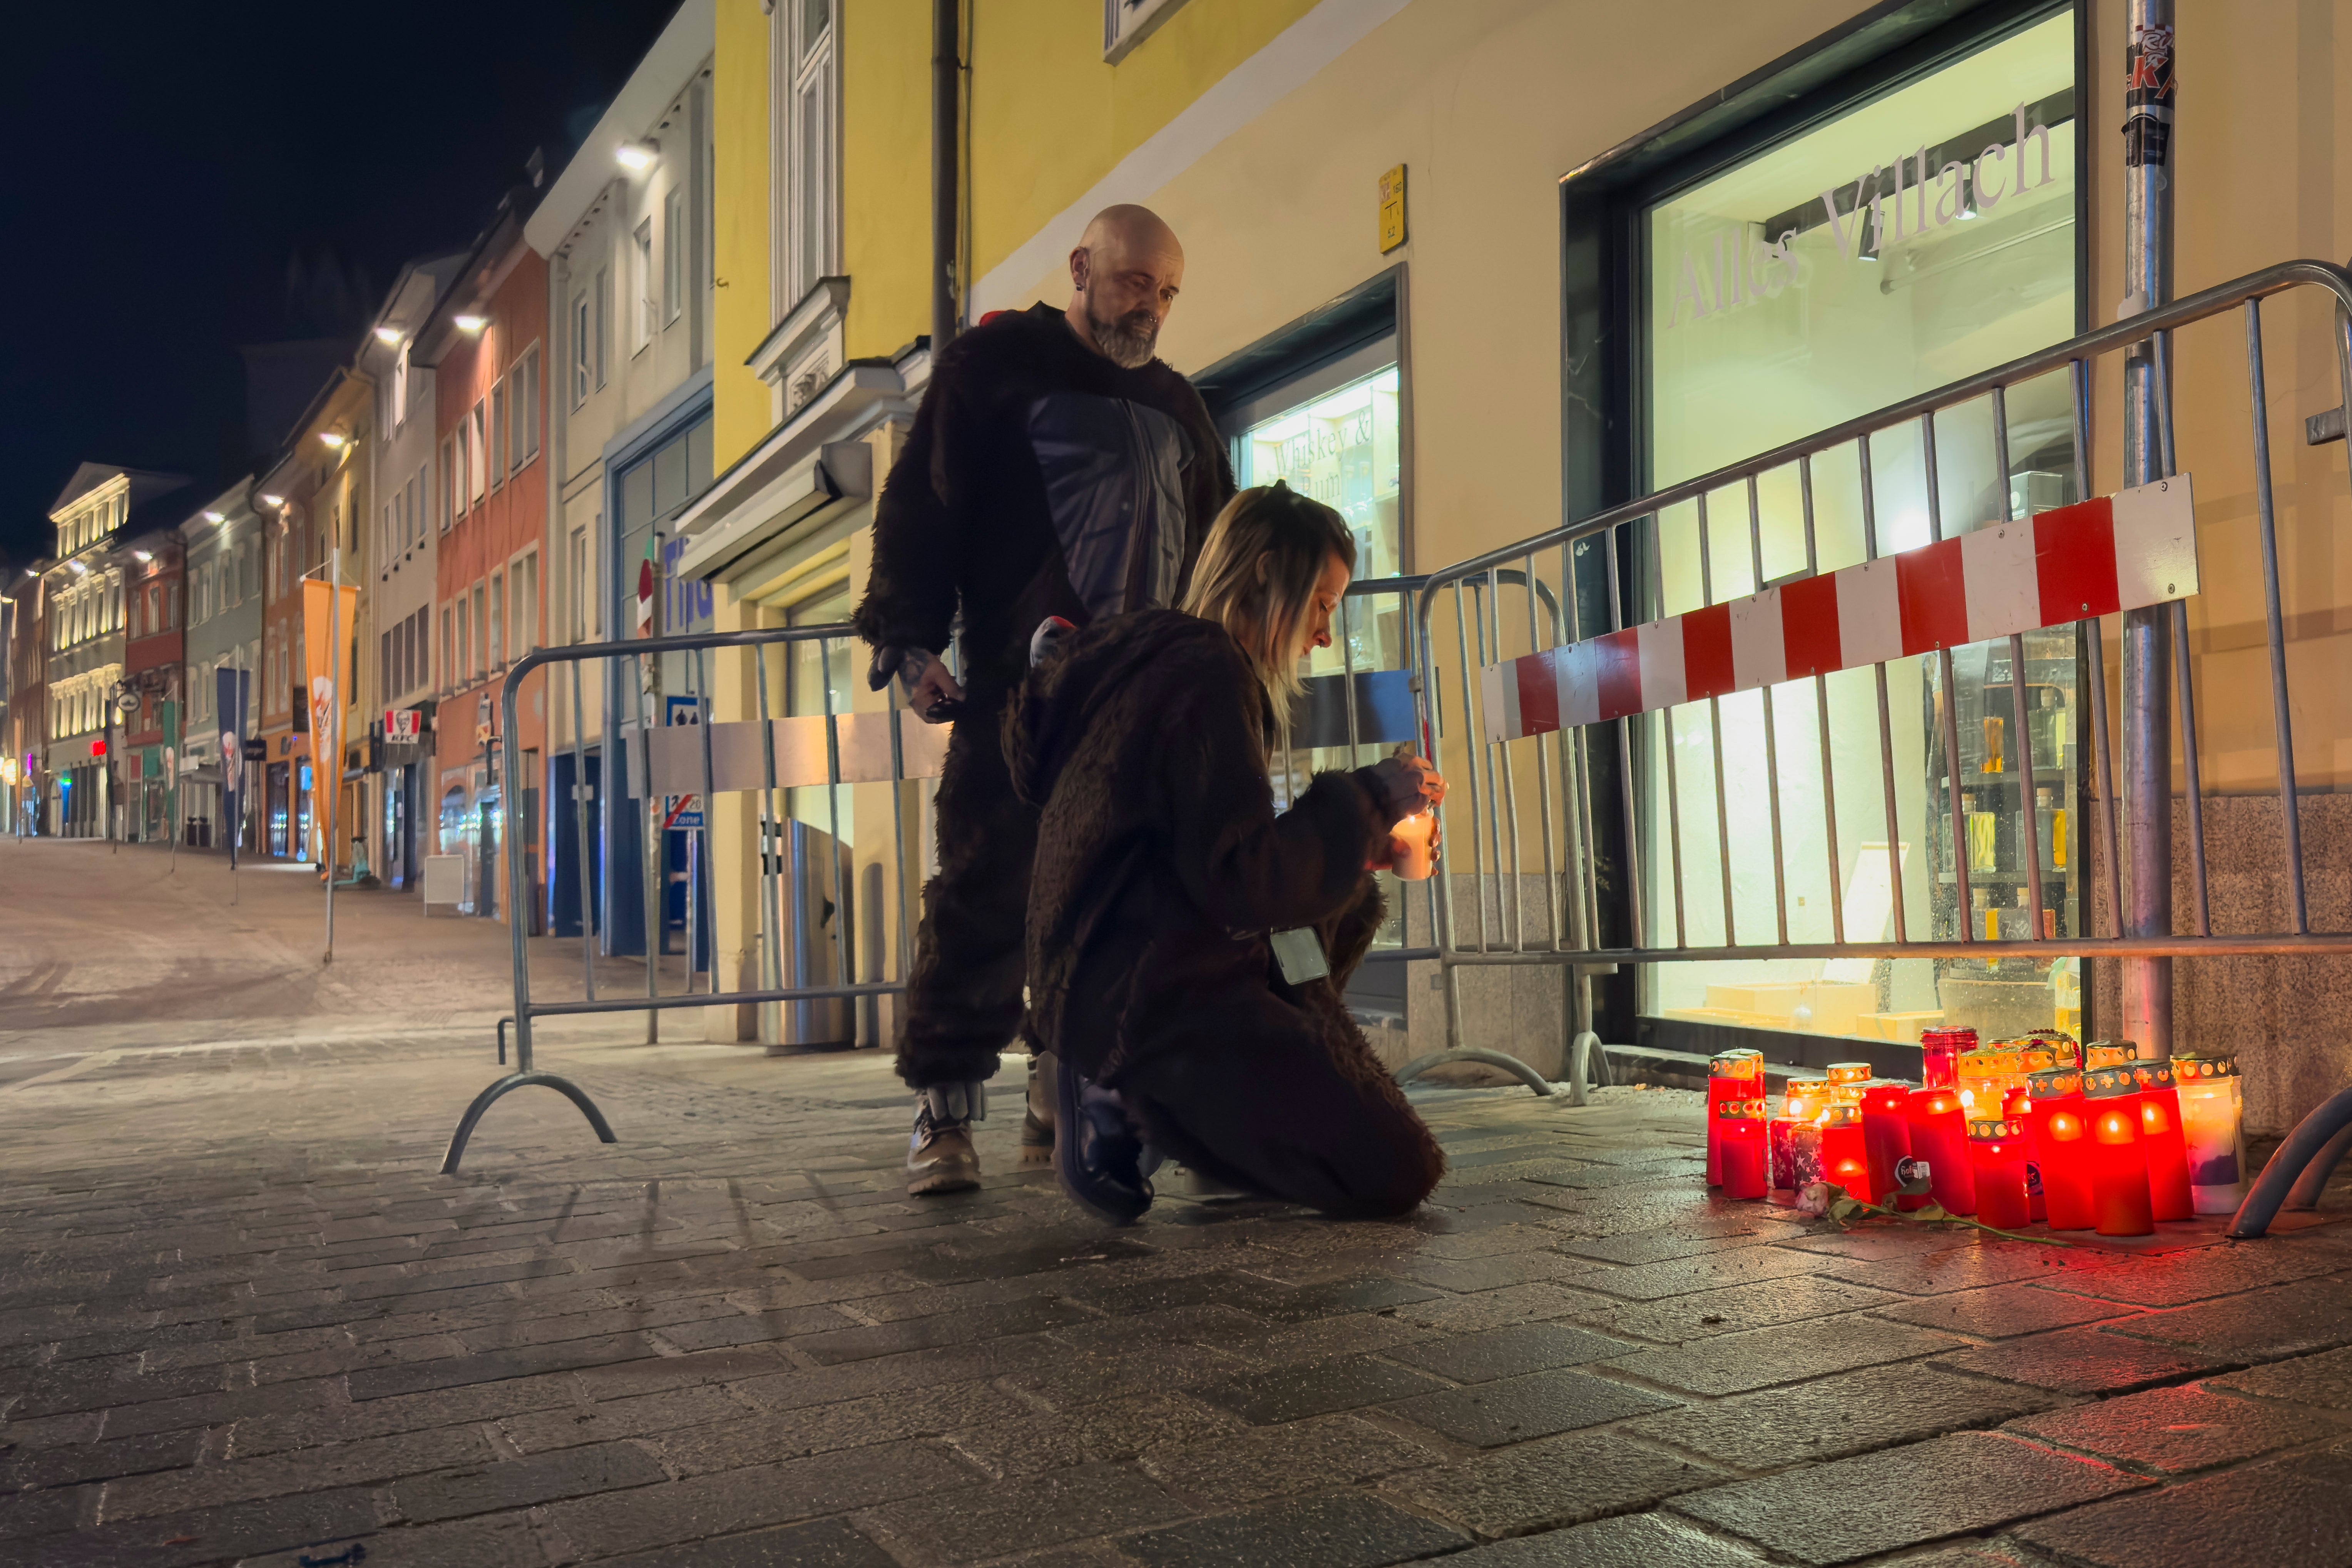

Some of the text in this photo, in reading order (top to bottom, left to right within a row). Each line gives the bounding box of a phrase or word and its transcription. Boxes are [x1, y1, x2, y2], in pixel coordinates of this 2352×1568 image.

[1668, 101, 2055, 329] Alles Villach
[1275, 410, 1371, 473] Whiskey &
[1303, 473, 1341, 502] Rum
[689, 800, 701, 810] 20
